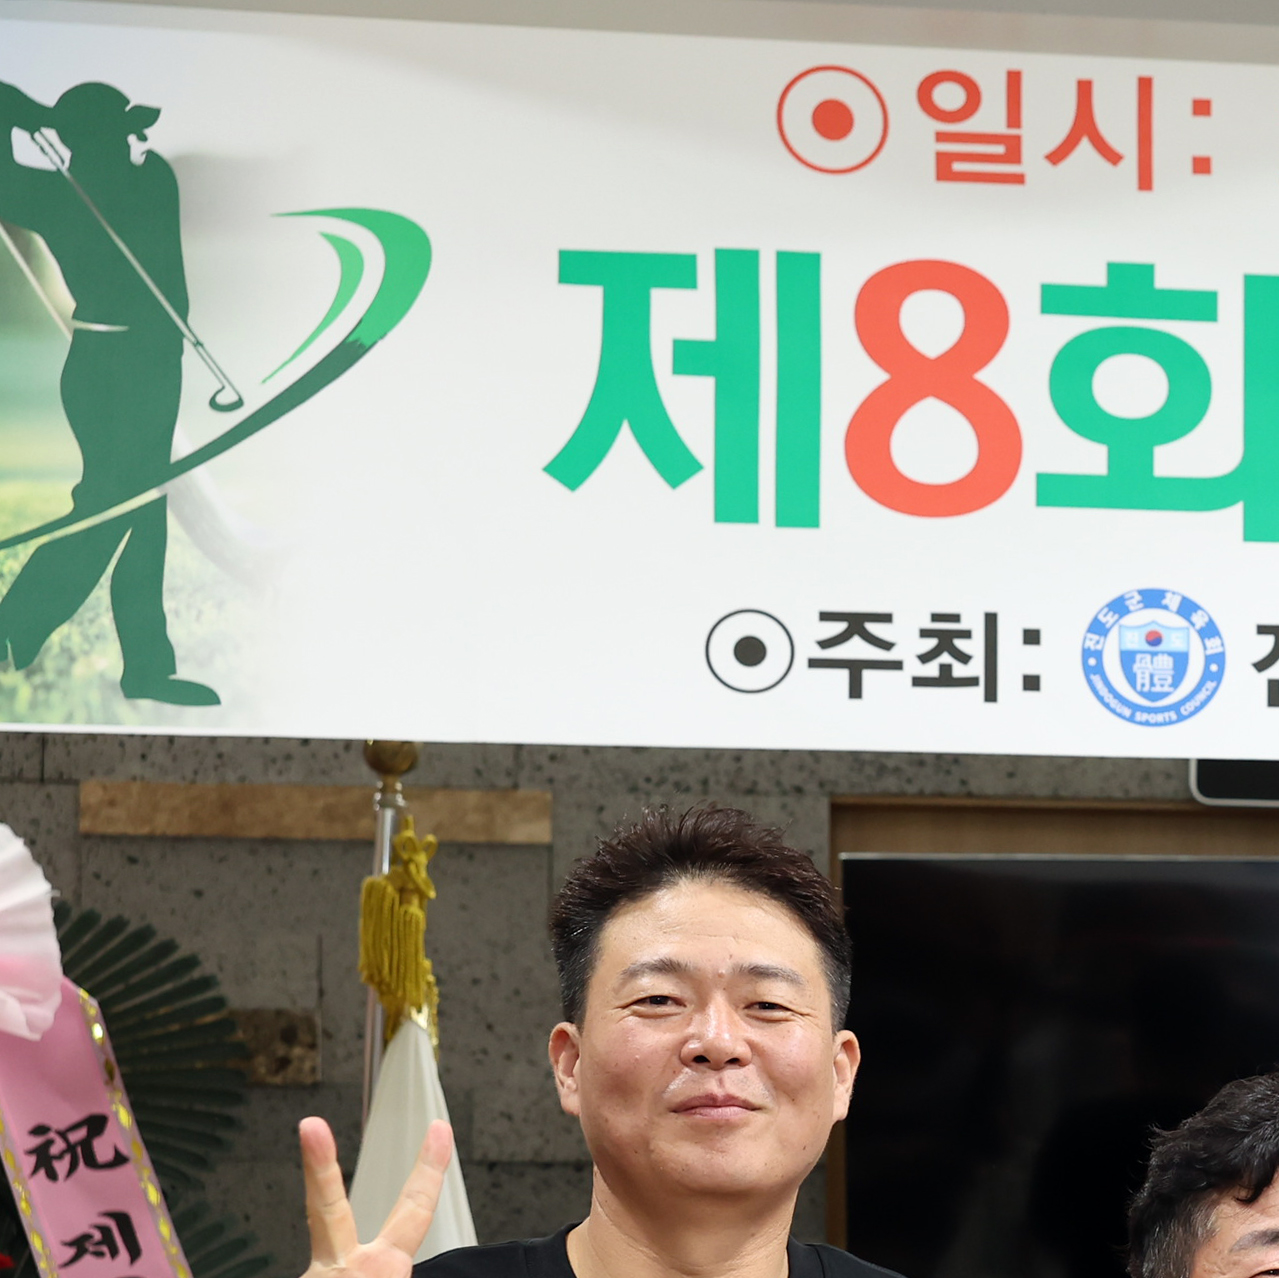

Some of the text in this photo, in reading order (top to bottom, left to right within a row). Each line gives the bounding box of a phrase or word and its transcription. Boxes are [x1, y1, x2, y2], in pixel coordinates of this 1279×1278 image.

[918, 70, 1211, 191] 일시:
[808, 612, 1040, 702] 주최:
[1134, 711, 1177, 724] SPORTS
[26, 1112, 132, 1182] 祝
